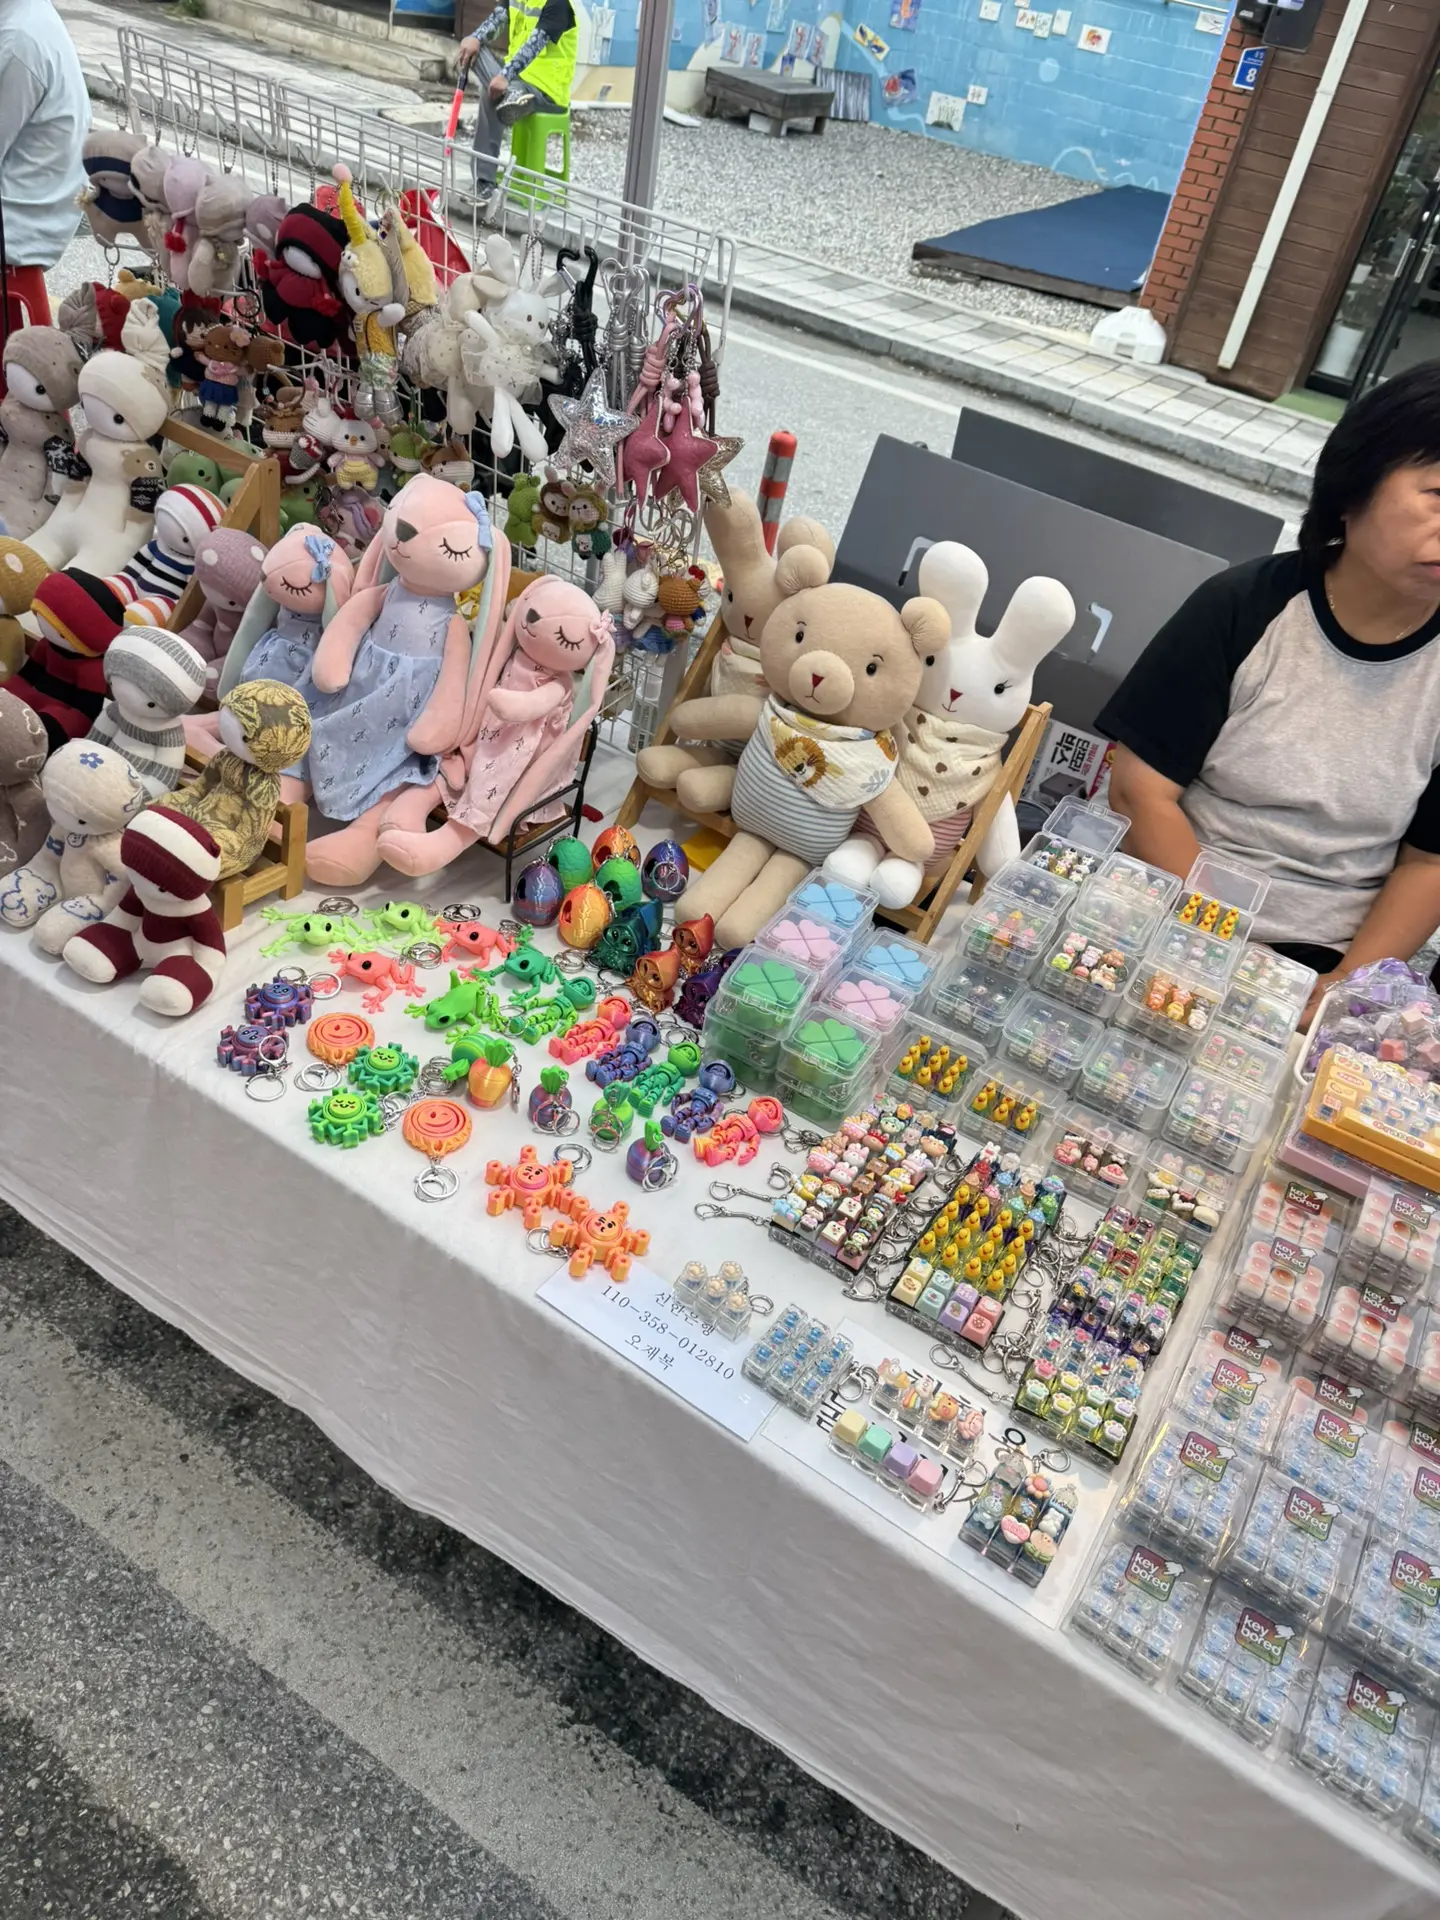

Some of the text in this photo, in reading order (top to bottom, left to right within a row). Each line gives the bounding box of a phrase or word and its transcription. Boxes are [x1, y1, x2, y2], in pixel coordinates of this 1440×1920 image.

[1050, 732, 1077, 765] 박스
[1067, 738, 1090, 772] 단프라
[1289, 1191, 1320, 1210] bored
[1290, 1186, 1309, 1201] key
[1395, 1203, 1427, 1223] bored
[1396, 1198, 1415, 1213] key
[1274, 1247, 1306, 1268] bored
[1275, 1241, 1296, 1256] key
[1363, 1294, 1396, 1315] bored
[1364, 1288, 1385, 1304] key
[654, 1290, 716, 1337] 신한은행
[600, 1285, 735, 1380] 110-358-012810
[1230, 1331, 1251, 1347] key
[624, 1334, 676, 1372] 오재복
[1229, 1338, 1261, 1359] bored
[1220, 1365, 1241, 1382] key
[1217, 1373, 1253, 1396] bored
[1321, 1380, 1342, 1395] key
[1319, 1386, 1353, 1409] bored
[1320, 1415, 1343, 1433] key
[1319, 1423, 1355, 1449] bored
[1414, 1436, 1440, 1455] bore
[1415, 1427, 1437, 1446] key
[1188, 1438, 1211, 1458] key
[1185, 1447, 1222, 1473] bored
[1293, 1493, 1316, 1514] key
[1291, 1503, 1328, 1530] bored
[1134, 1552, 1159, 1574] key
[1397, 1558, 1423, 1578] key
[1131, 1561, 1170, 1591] bored
[1395, 1567, 1437, 1596] bored
[1243, 1614, 1268, 1637] key
[1241, 1623, 1281, 1655] bored
[1355, 1679, 1380, 1703] key
[1353, 1690, 1394, 1723] bored
